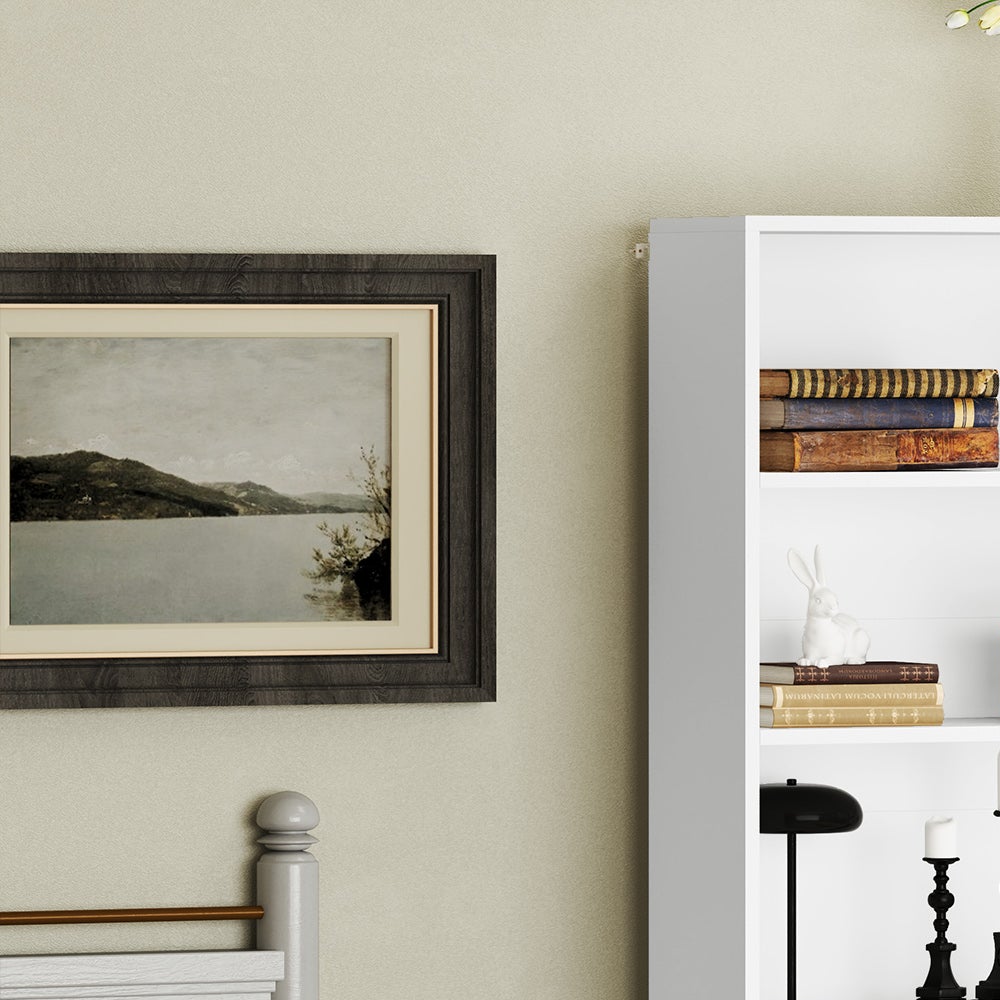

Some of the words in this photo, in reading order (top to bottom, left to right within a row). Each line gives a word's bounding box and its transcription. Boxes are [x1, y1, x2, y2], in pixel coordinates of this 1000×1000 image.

[785, 692, 841, 700] LATINARUM
[845, 692, 881, 700] VOCUM
[884, 692, 935, 700] LATERCULI
